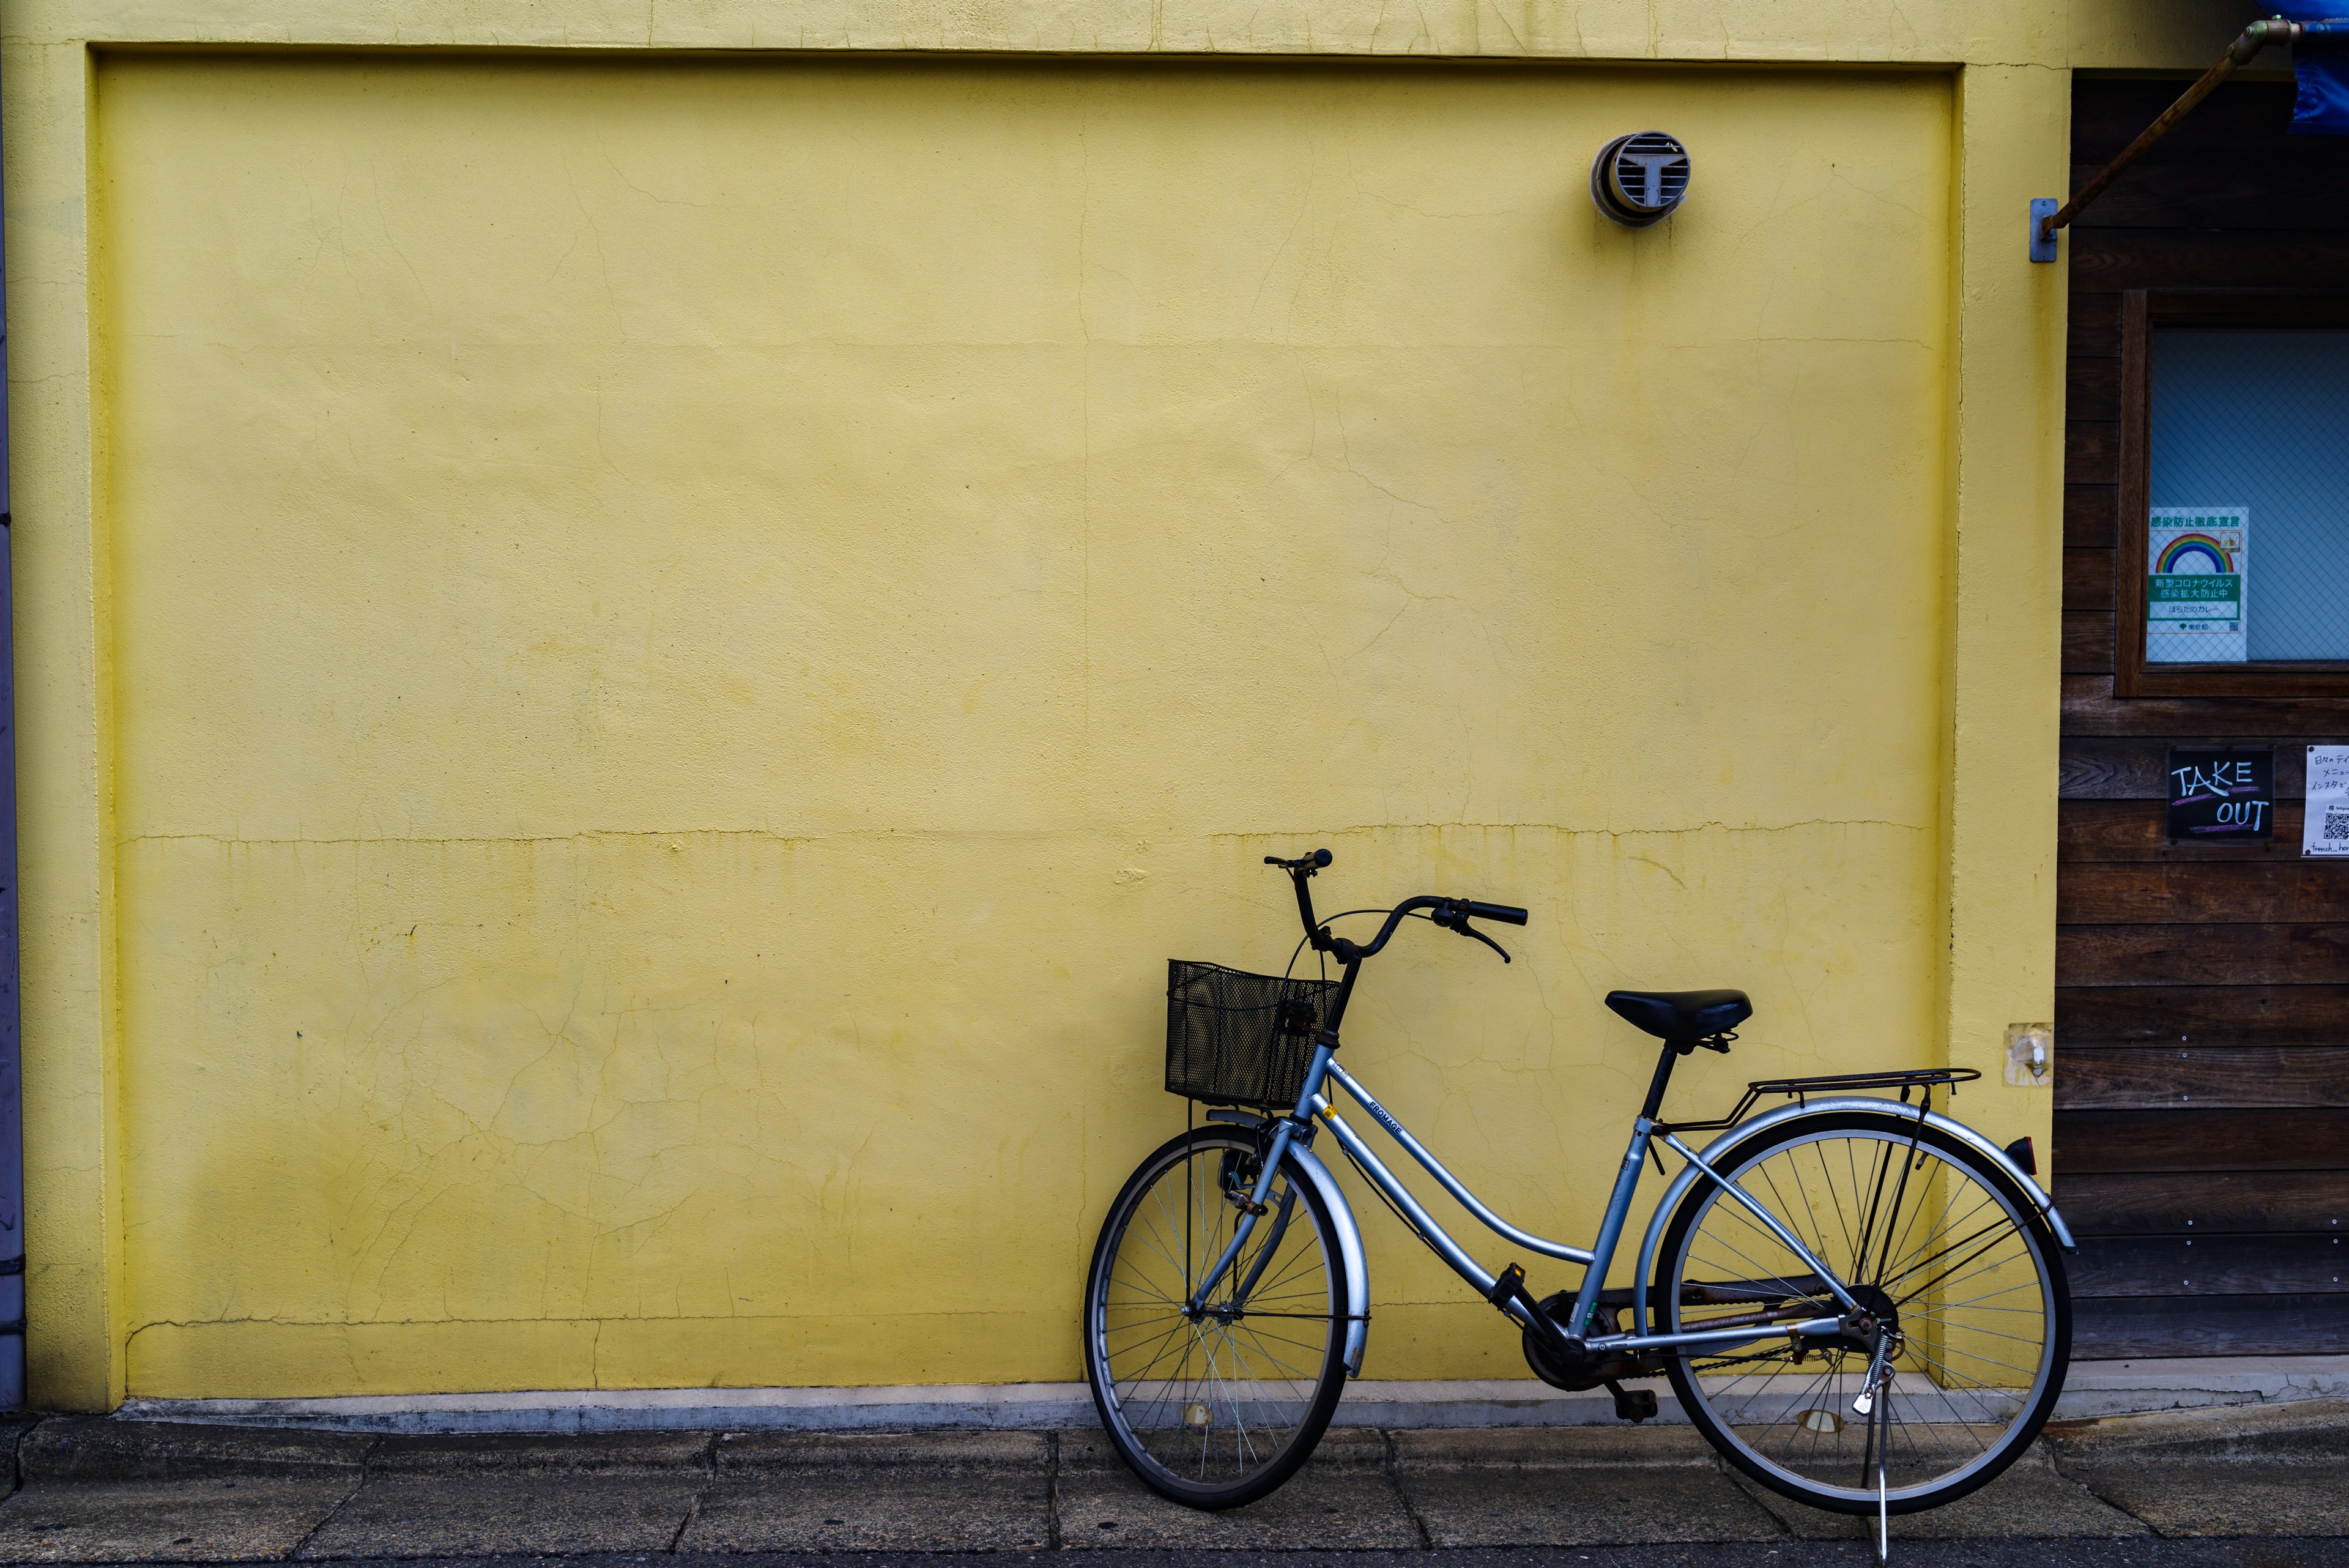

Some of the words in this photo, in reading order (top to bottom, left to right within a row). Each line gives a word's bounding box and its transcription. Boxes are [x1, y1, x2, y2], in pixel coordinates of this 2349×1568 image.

[2151, 516, 2240, 527] 感染防止徹底宣言
[2155, 579, 2233, 588] 新型コロナウイルス
[2161, 589, 2228, 598] 感染拡大防止中
[2171, 761, 2253, 797] TAKE
[2217, 800, 2269, 831] OUT
[1369, 1101, 1402, 1134] FROMAGE
